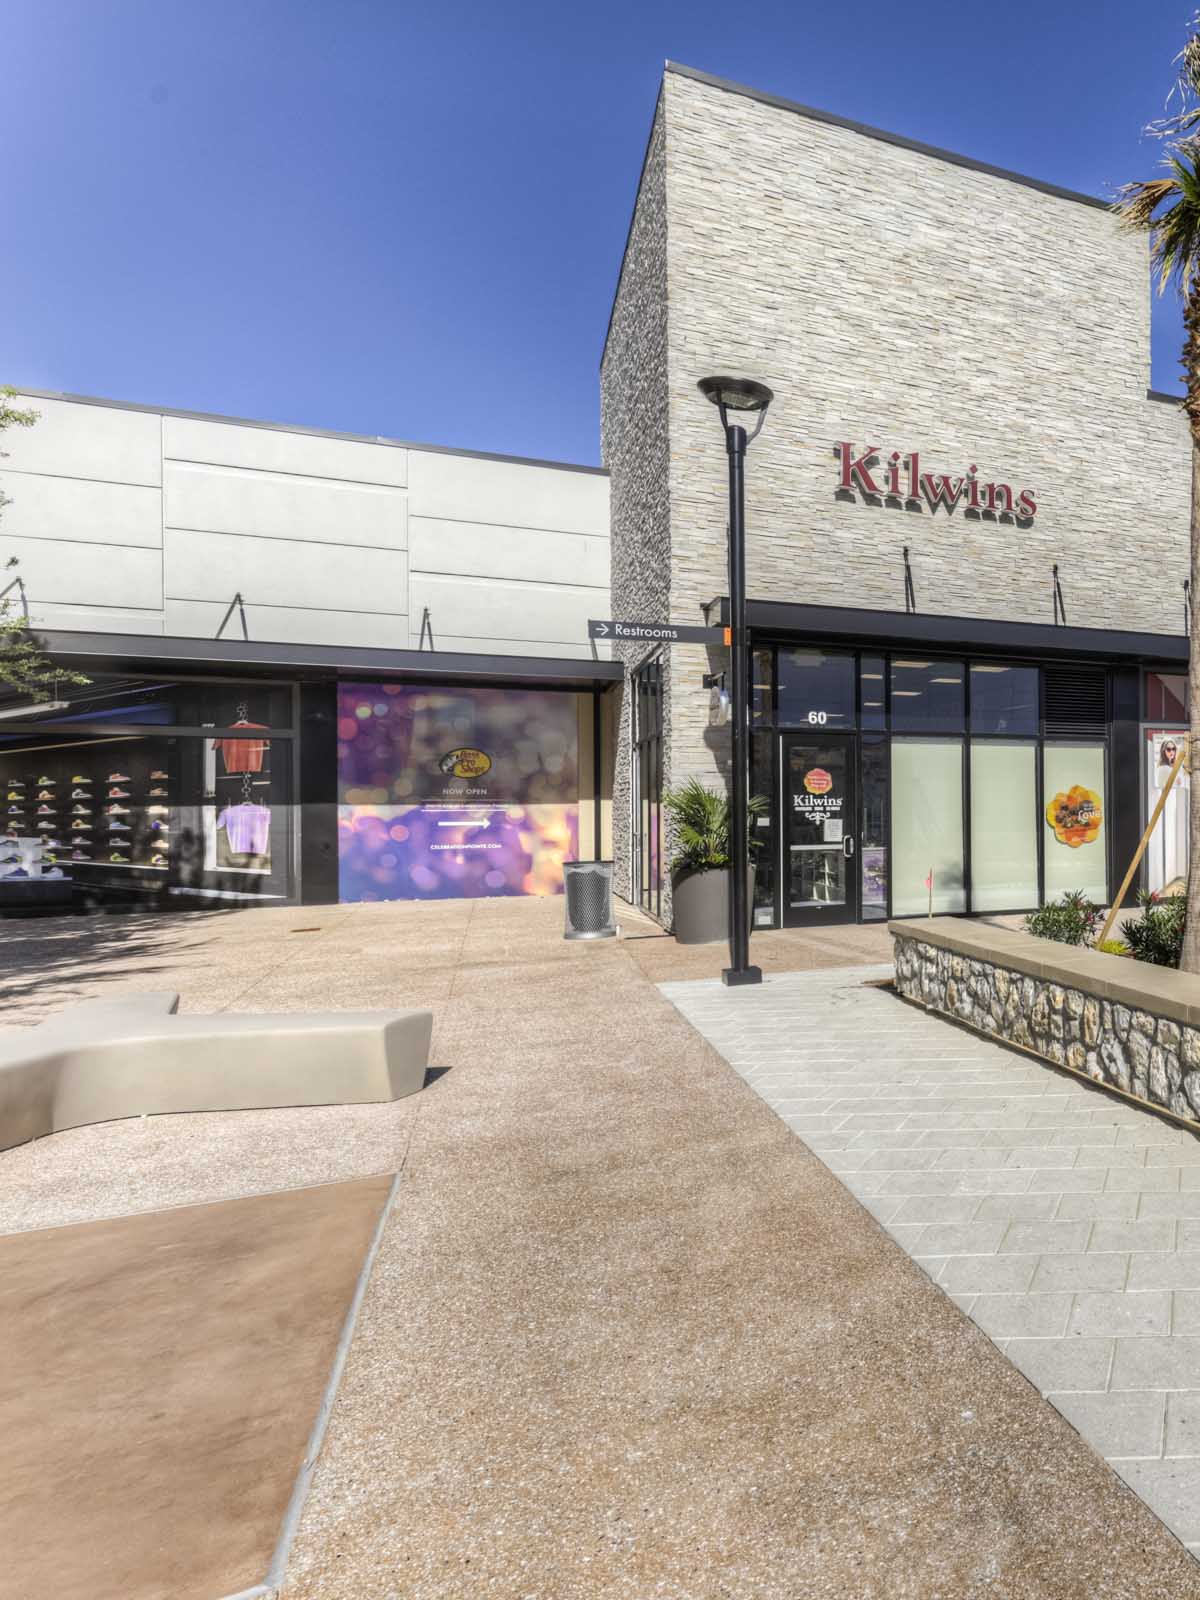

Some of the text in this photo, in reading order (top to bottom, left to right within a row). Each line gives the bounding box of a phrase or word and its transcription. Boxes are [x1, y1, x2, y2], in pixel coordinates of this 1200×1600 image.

[838, 441, 1038, 518] Kilwins
[615, 623, 678, 639] Restrooms
[808, 711, 828, 725] 60
[793, 795, 843, 806] Kilwins
